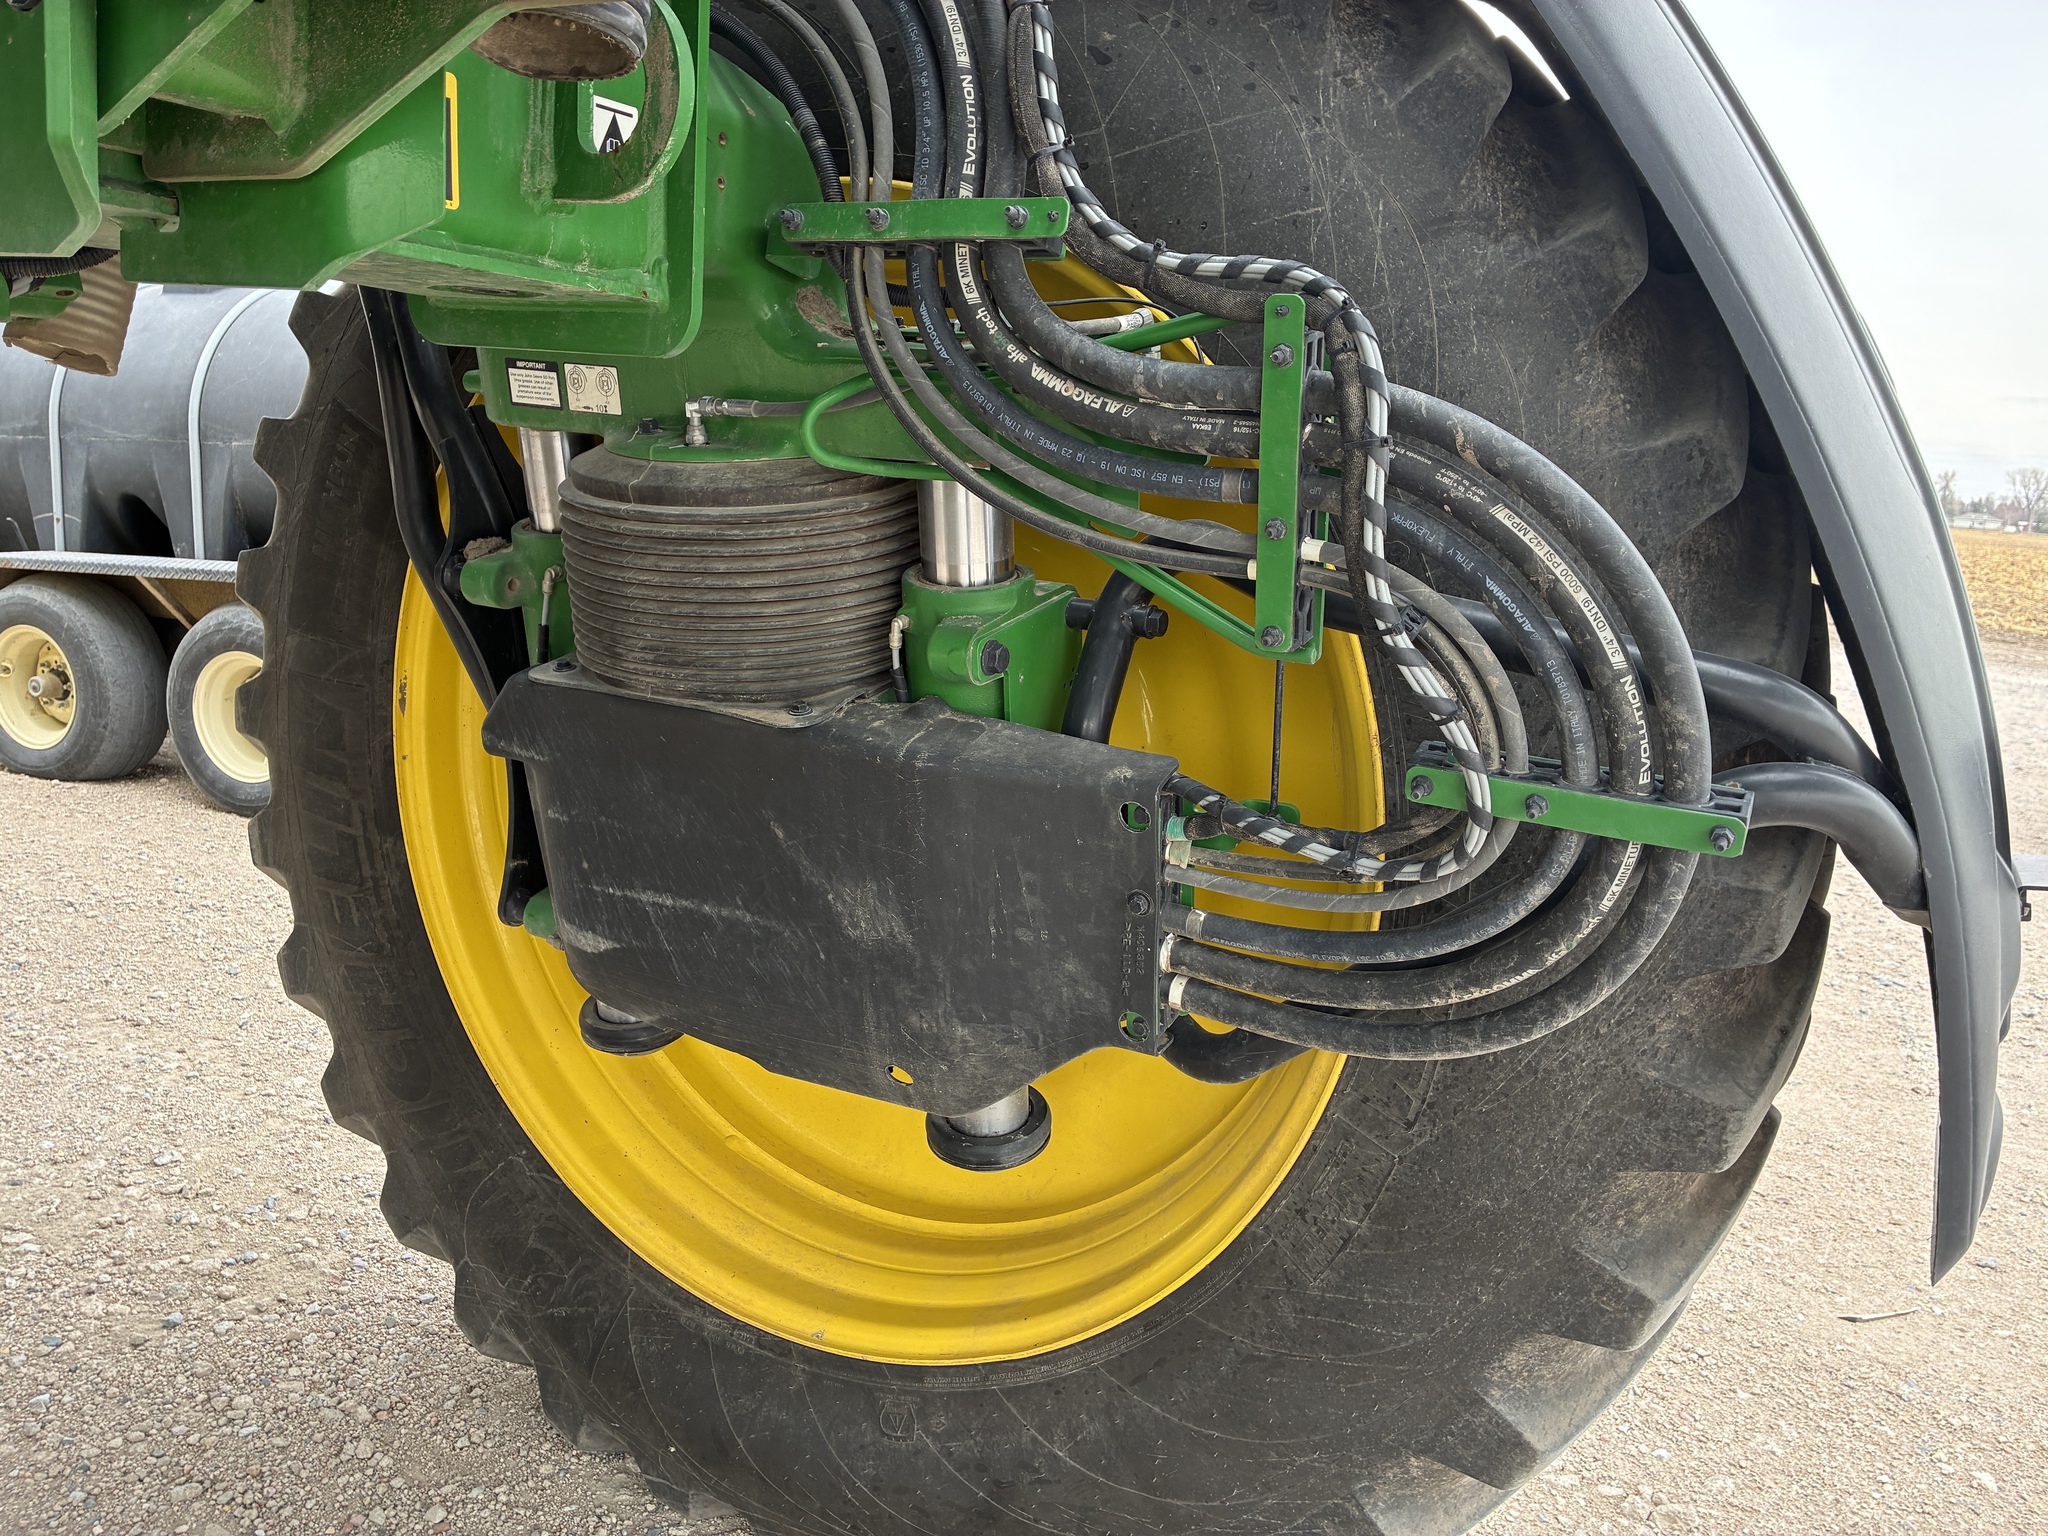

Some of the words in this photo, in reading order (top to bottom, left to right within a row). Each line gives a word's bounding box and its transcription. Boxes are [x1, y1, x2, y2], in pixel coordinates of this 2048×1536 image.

[946, 4, 962, 35] (DN19)
[955, 38, 967, 57] 3/4"
[921, 71, 930, 87] MPa
[960, 75, 977, 175] EVOLUTION
[912, 262, 921, 290] ITALY
[964, 280, 976, 295] 6K
[920, 300, 950, 359] ALFAGOMMA
[516, 361, 546, 369] IMPORTANT
[1031, 362, 1122, 414] ALFAGOMMA
[998, 412, 1022, 432] ITALY
[1024, 428, 1035, 440] IN
[1038, 436, 1059, 452] MADE
[1061, 447, 1073, 458] 23
[1100, 462, 1110, 471] 19
[1115, 464, 1127, 474] DN
[1151, 472, 1168, 482] 857
[1172, 475, 1184, 484] EN
[1390, 512, 1436, 542] FLEXOPAK
[1502, 512, 1531, 537] MPa)
[1528, 536, 1546, 552] (42
[1447, 547, 1475, 572] ITALY
[1543, 551, 1563, 570] PSI
[1560, 568, 1582, 594] 6000
[1485, 574, 1536, 633] ALFAGOMMA
[1580, 596, 1608, 633] (DN19)
[1603, 635, 1621, 658] 3/4"
[1567, 710, 1582, 738] ITALY
[1620, 674, 1652, 785] EVOLUTION
[1576, 743, 1586, 755] IN
[1607, 890, 1620, 902] 6K
